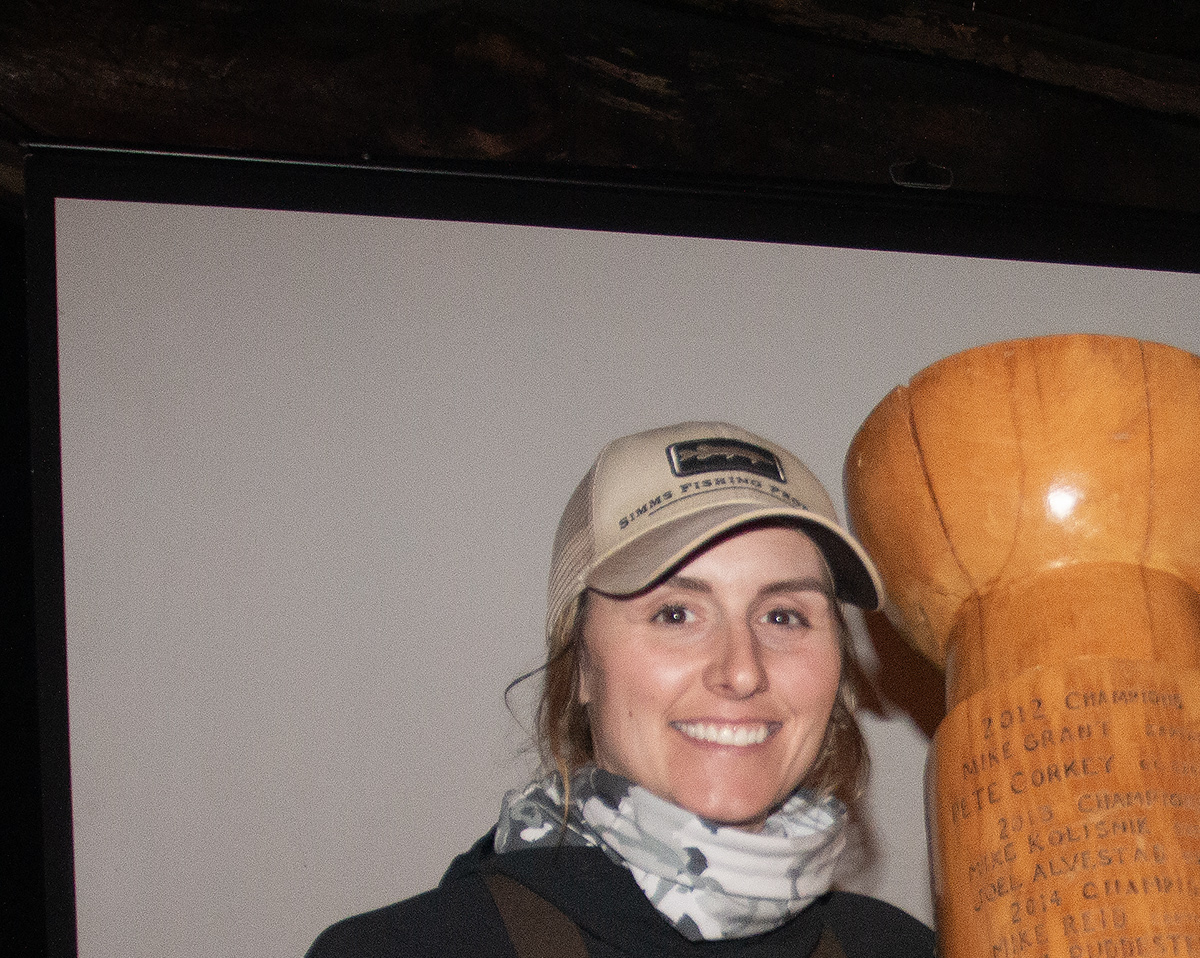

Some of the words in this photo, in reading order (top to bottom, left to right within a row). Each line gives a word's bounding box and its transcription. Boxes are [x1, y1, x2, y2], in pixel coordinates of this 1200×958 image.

[618, 490, 674, 530] SIMMS
[679, 476, 763, 492] FISHING
[982, 698, 1046, 740] 2012
[962, 741, 1014, 780] MIKE
[1023, 720, 1111, 752] GRANT
[951, 781, 1000, 825] PETE
[1010, 754, 1116, 795] CORKEY
[968, 842, 1017, 882] MIKE
[1011, 889, 1062, 924] 2014
[1062, 906, 1127, 937] REID
